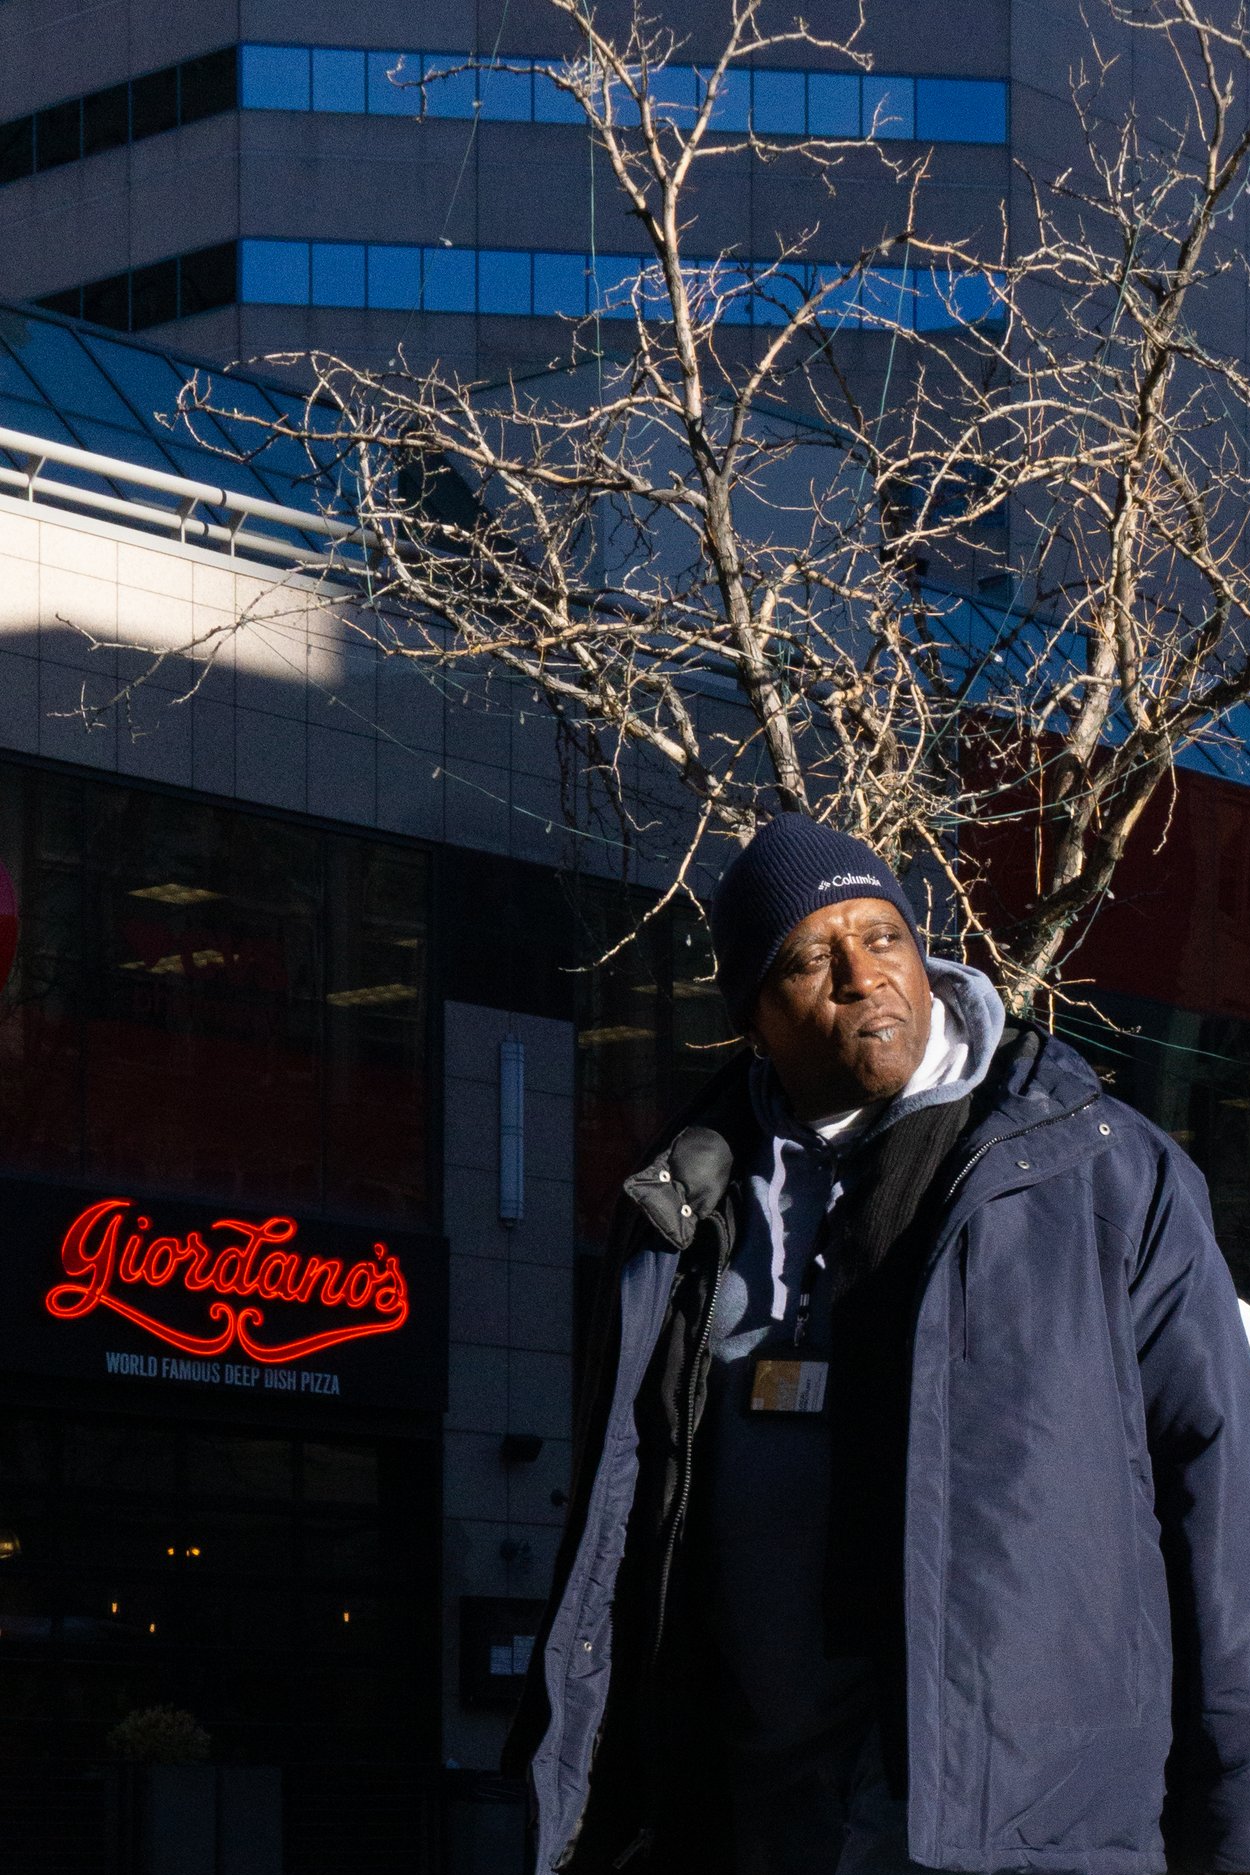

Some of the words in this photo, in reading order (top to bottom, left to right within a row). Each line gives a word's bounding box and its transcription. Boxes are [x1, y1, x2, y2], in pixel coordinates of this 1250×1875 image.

[832, 872, 882, 887] Columbia
[45, 1199, 410, 1363] Giordano's
[105, 1351, 158, 1377] WORLD
[161, 1357, 221, 1383] FAMOUS
[224, 1363, 260, 1387] DEEP
[263, 1368, 297, 1391] DISH
[300, 1371, 340, 1395] PIZZA
